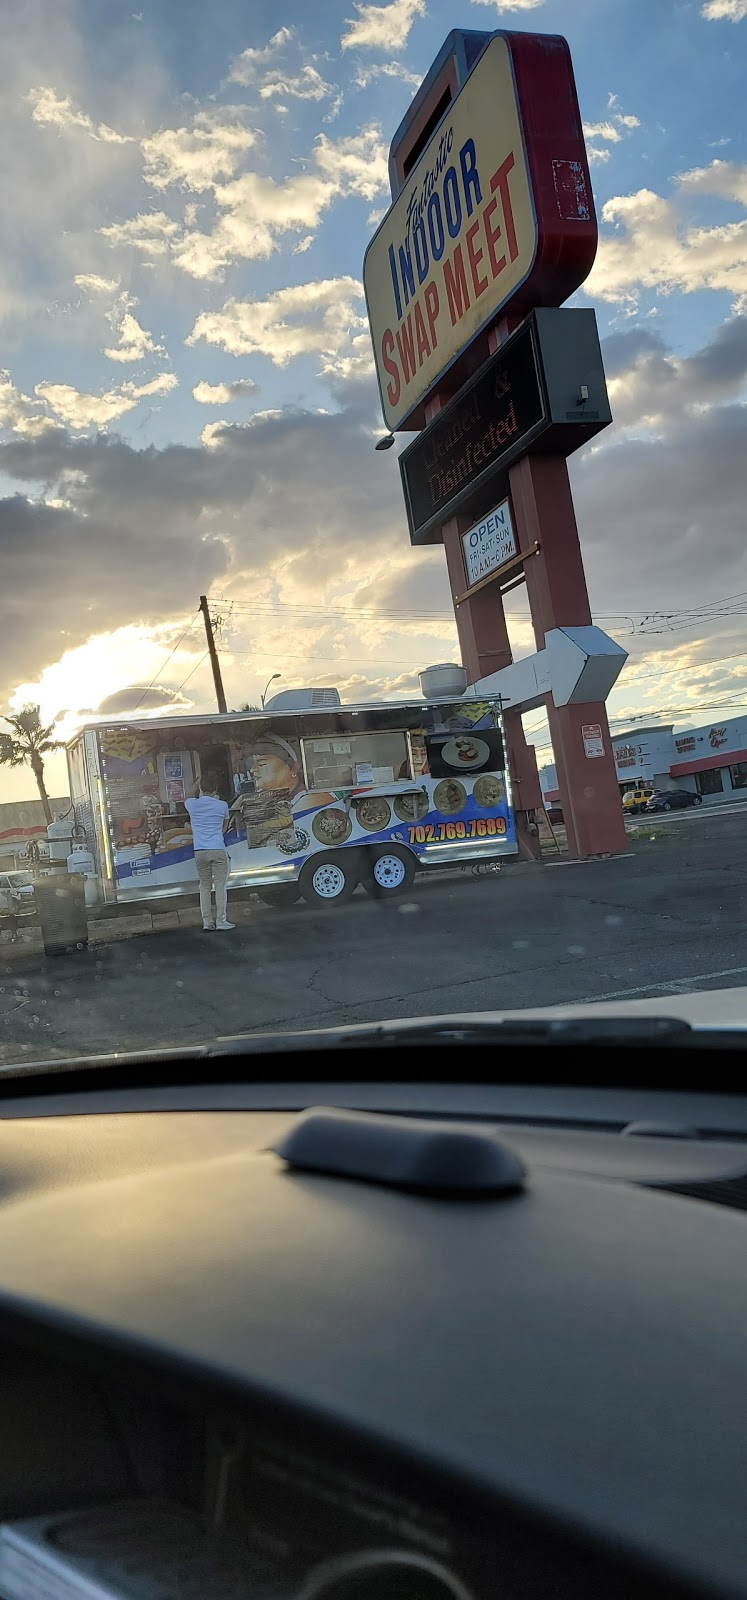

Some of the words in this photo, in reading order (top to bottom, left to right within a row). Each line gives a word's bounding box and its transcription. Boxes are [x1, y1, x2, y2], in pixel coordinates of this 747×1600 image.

[388, 138, 483, 321] INDOOR
[405, 126, 454, 234] Fantastic
[381, 280, 440, 407] SWAP
[443, 151, 519, 327] MEET
[428, 400, 519, 507] Disinfected
[469, 510, 505, 548] OPEN
[407, 817, 507, 844] 702.769.7689
